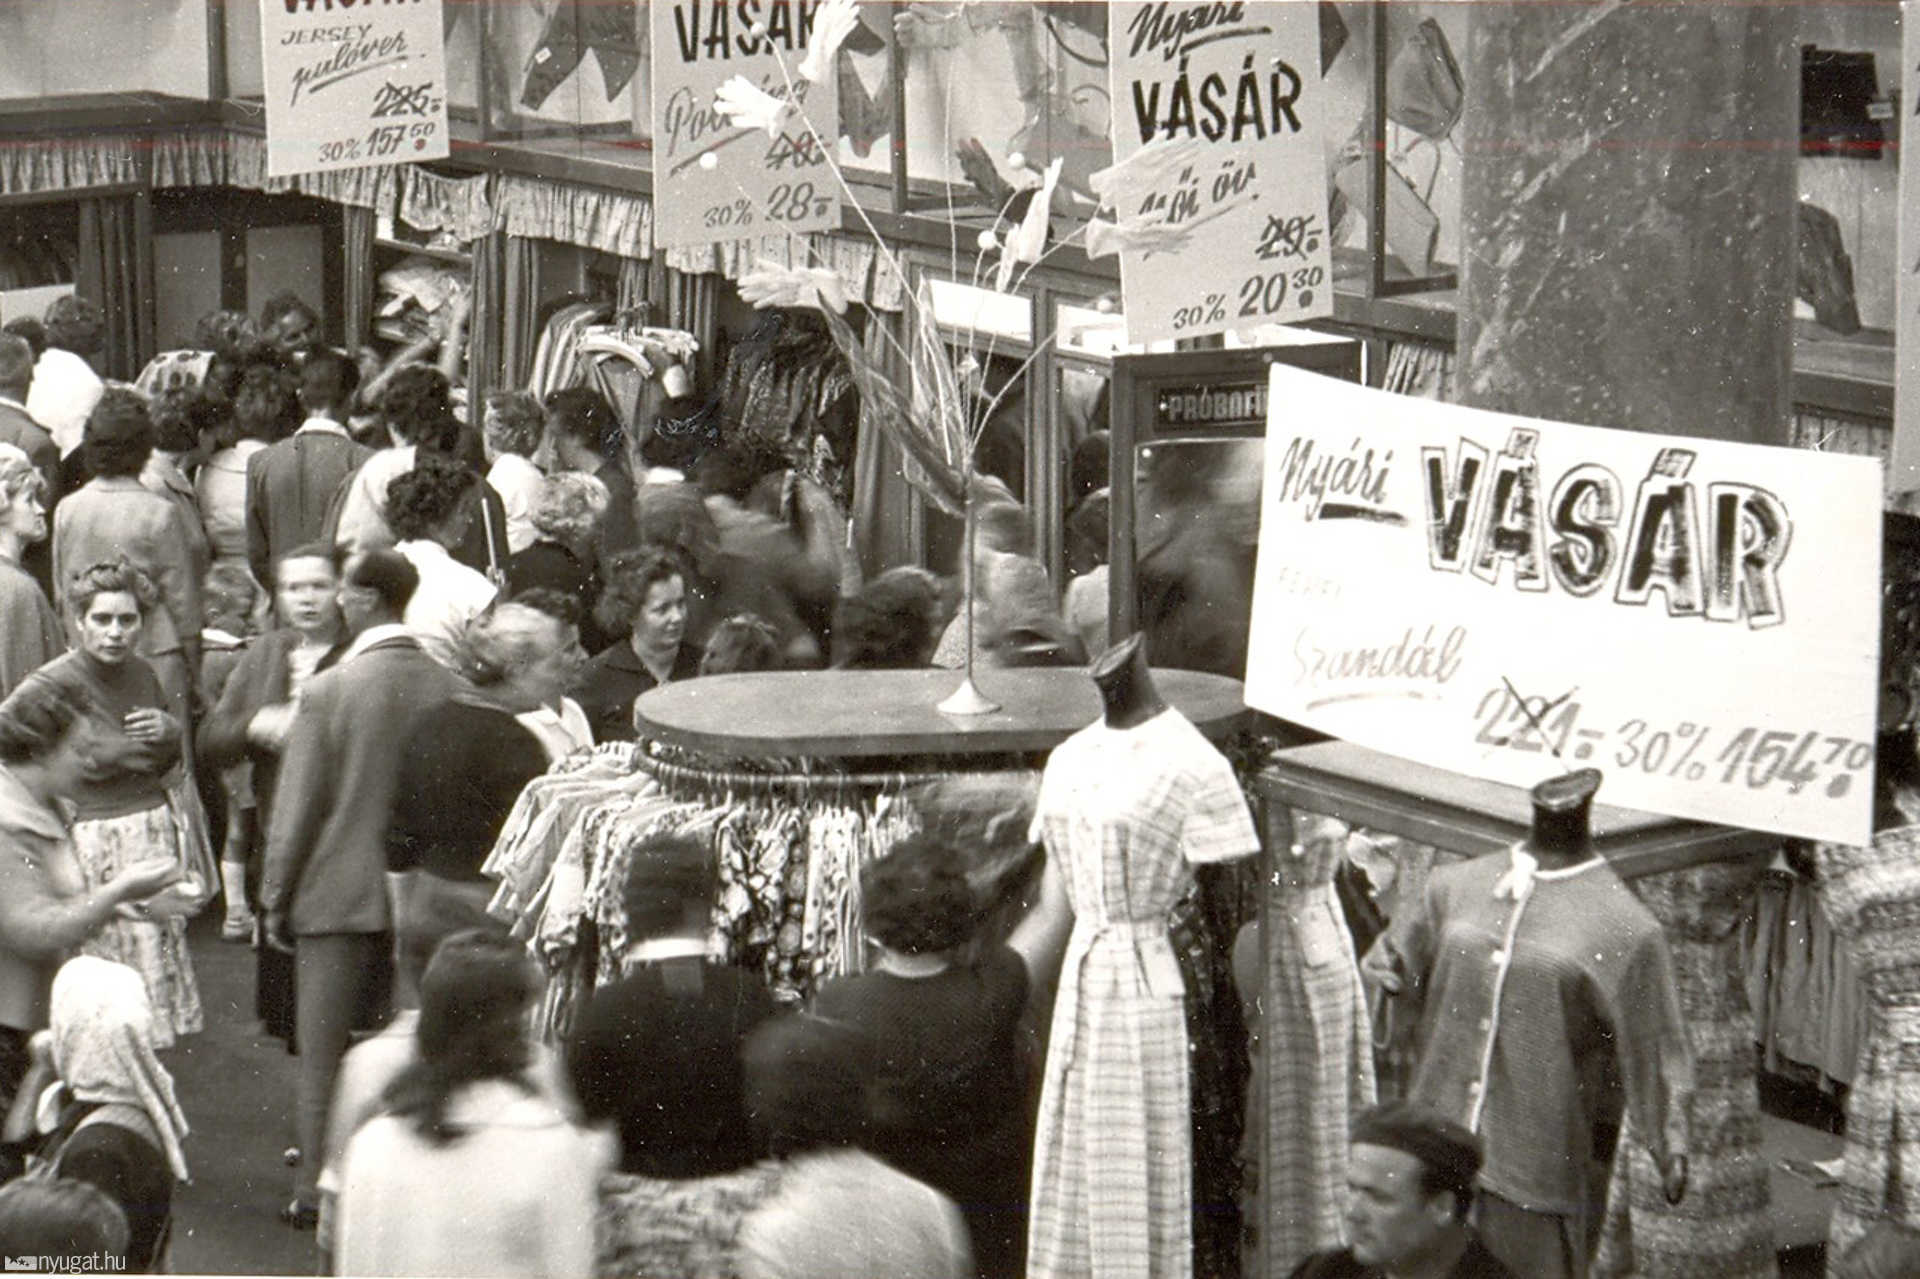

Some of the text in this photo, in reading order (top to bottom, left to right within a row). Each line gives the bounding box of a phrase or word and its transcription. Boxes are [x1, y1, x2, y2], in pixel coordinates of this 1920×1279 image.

[281, 24, 372, 45] JERSEY
[289, 30, 408, 107] pulóver
[1132, 50, 1302, 144] VÁSÁR
[319, 138, 361, 163] 30%
[703, 198, 752, 228] 30%
[1173, 293, 1226, 330] 30%
[1279, 426, 1794, 630] Nyári VÁSÁR
[1292, 623, 1467, 689] Szandál
[1615, 718, 1711, 782] 30%
